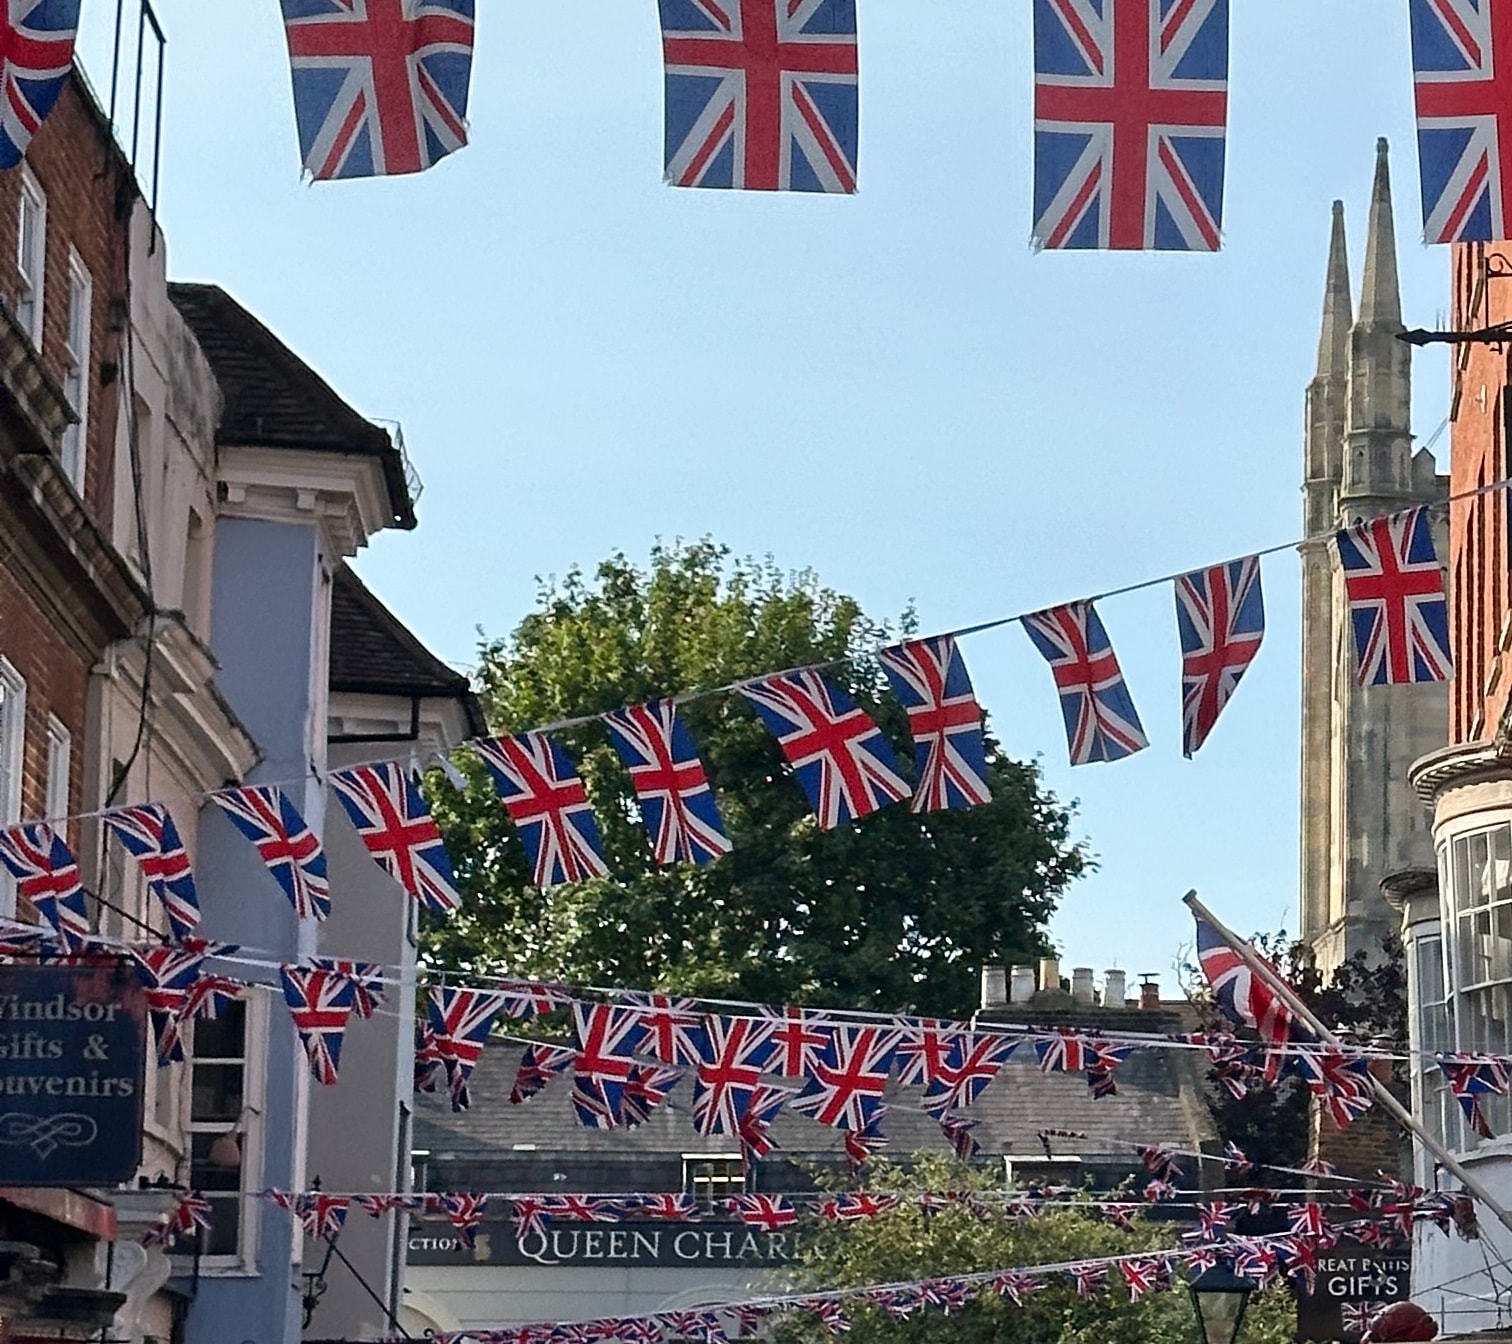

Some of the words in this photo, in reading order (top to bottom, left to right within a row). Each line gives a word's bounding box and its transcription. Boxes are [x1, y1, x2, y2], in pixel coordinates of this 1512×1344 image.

[82, 1033, 110, 1060] &
[0, 1070, 135, 1096] uvenirs
[518, 1230, 662, 1264] QUEEN
